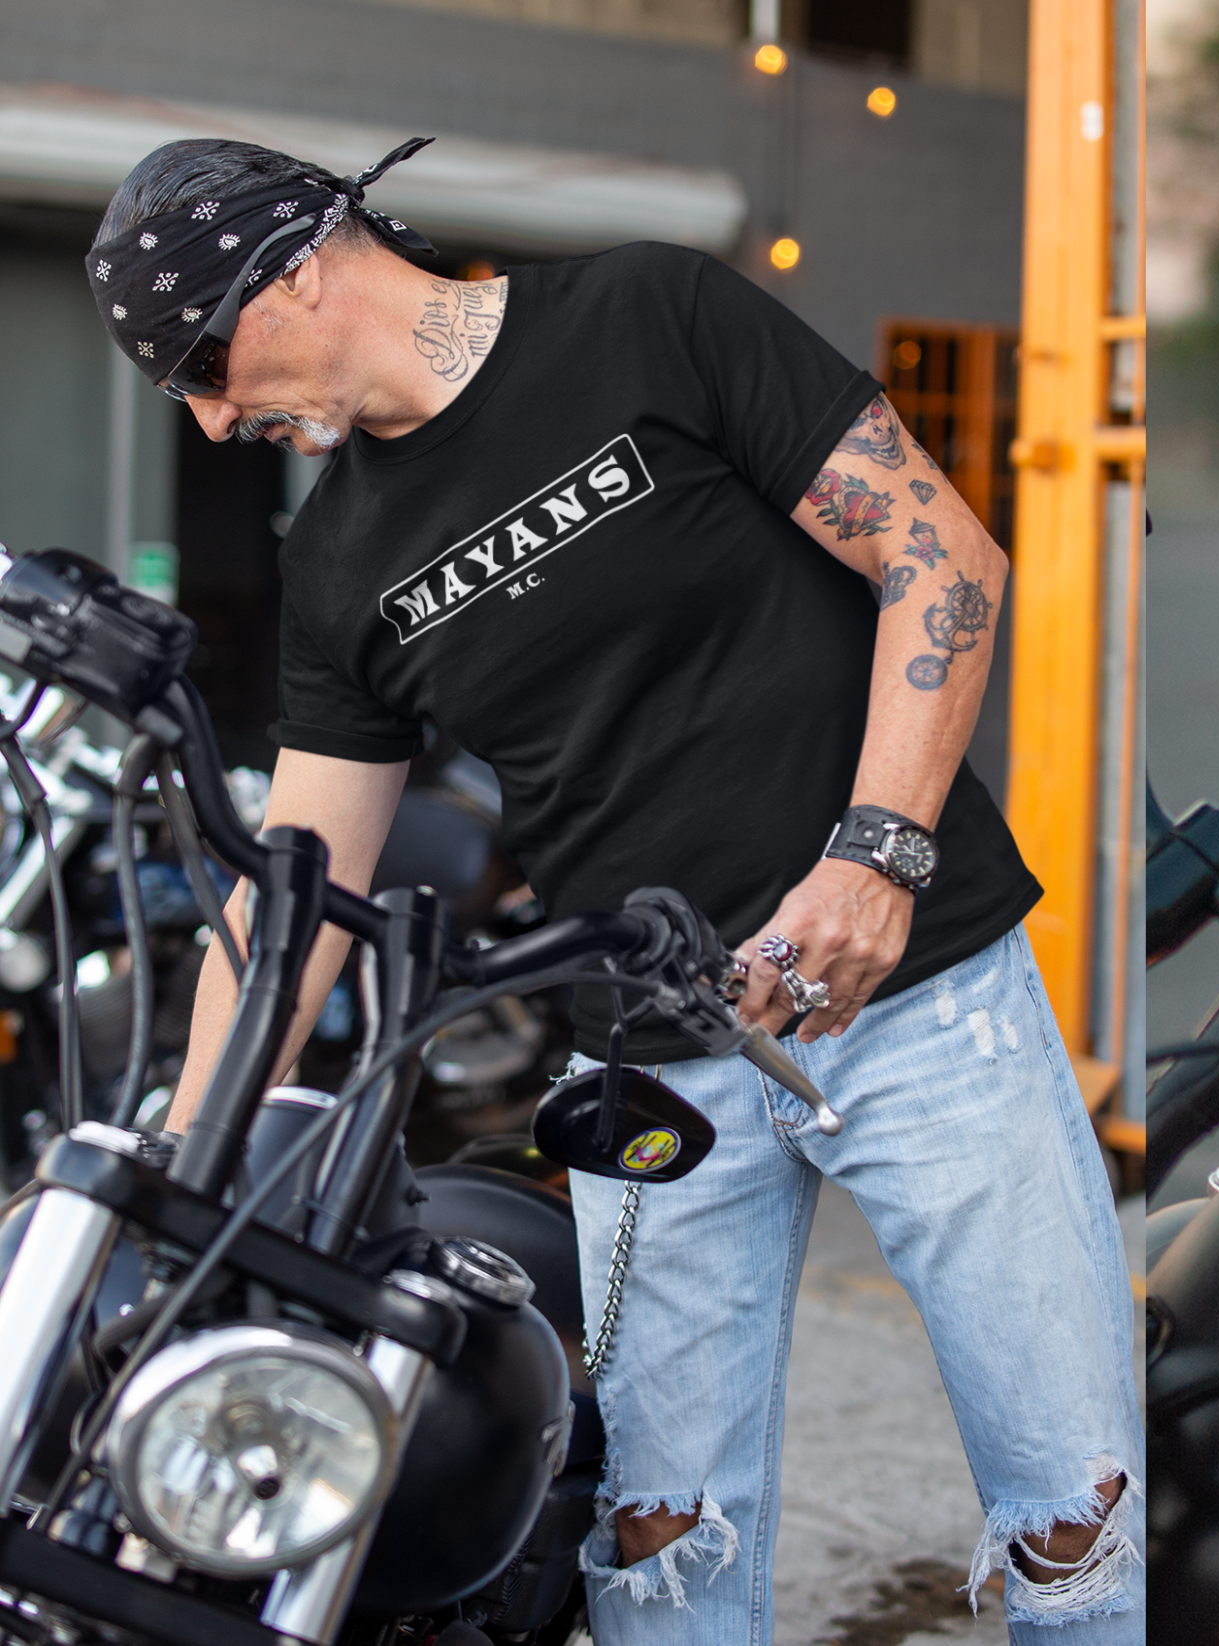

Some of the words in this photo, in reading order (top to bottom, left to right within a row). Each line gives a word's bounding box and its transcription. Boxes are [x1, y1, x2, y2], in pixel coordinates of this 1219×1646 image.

[412, 298, 468, 381] Dios
[460, 332, 490, 357] mi
[393, 454, 630, 627] MAYANS
[505, 572, 546, 600] M.C.
